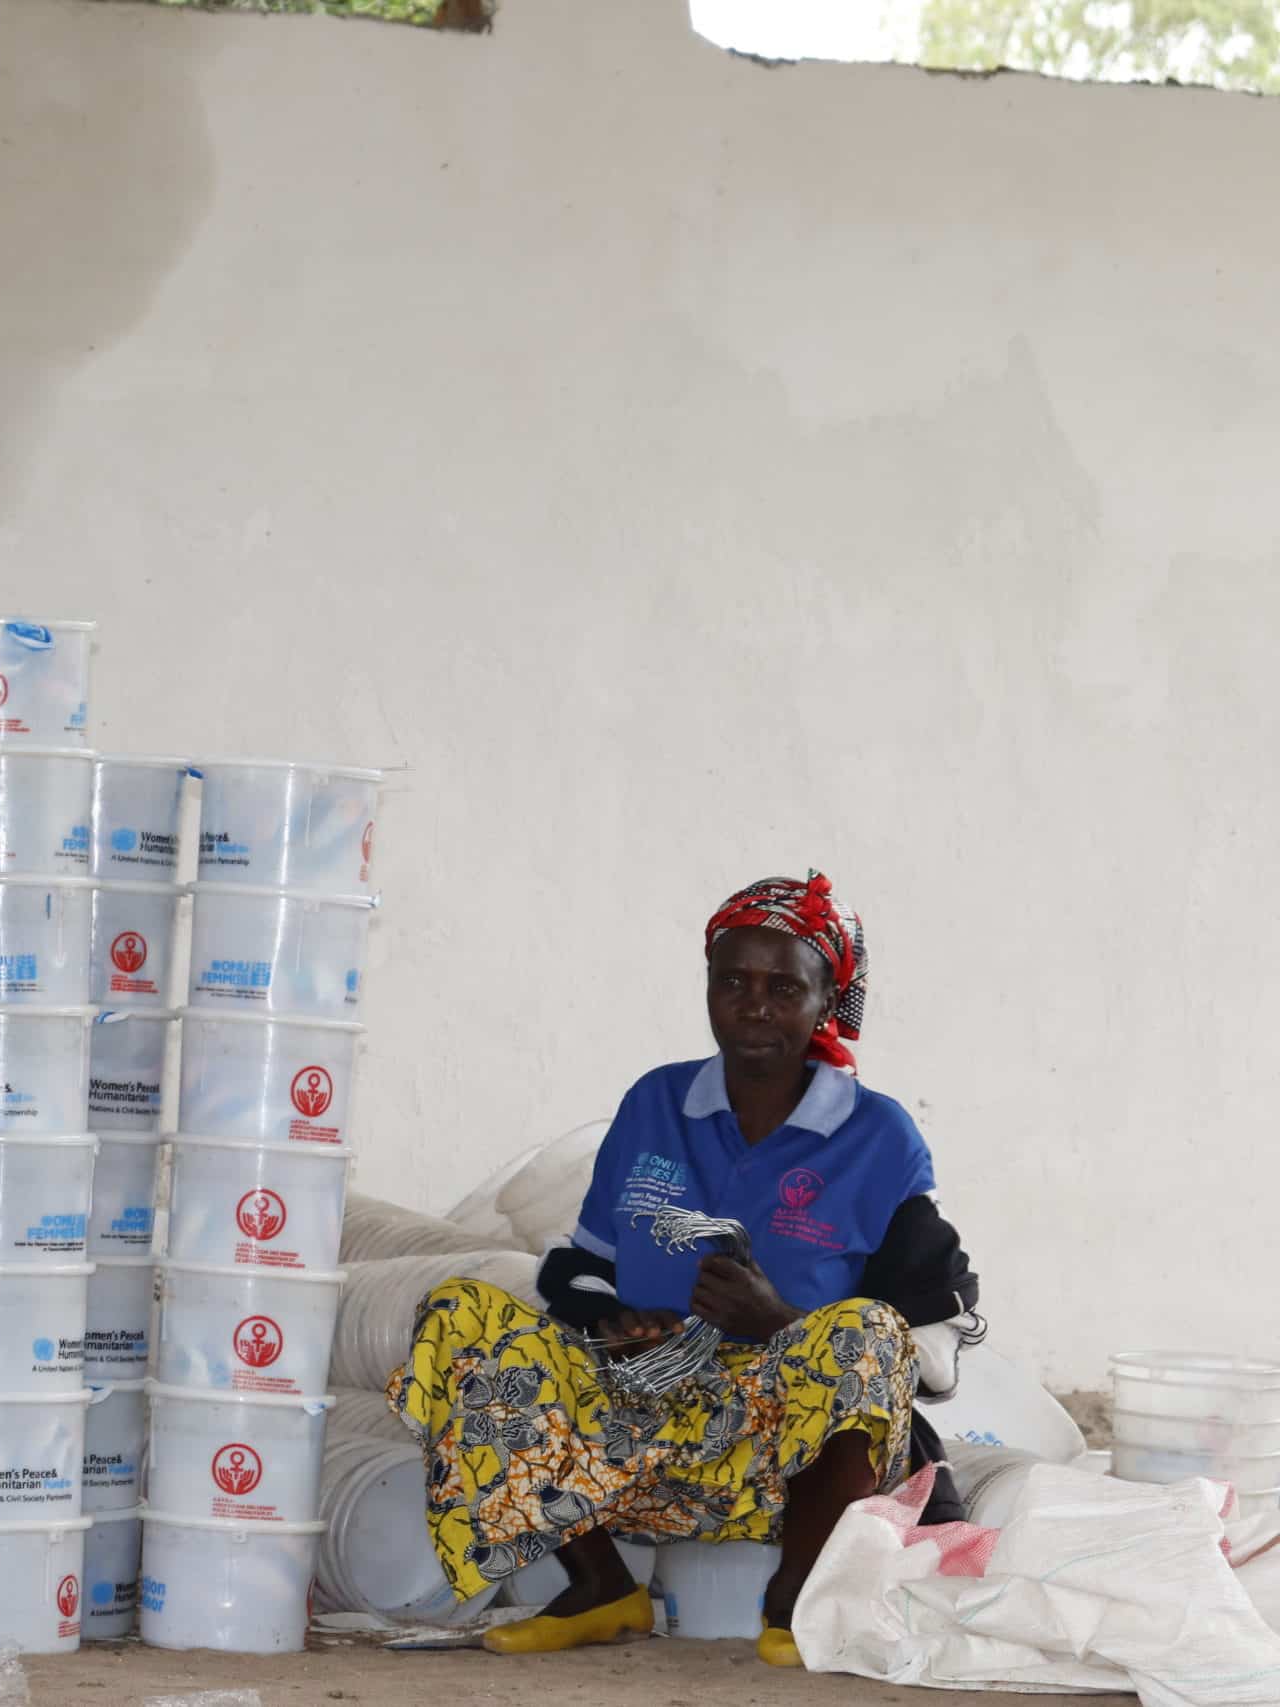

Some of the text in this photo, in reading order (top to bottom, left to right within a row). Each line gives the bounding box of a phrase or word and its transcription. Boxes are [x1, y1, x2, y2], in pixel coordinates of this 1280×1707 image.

[89, 1079, 136, 1092] Women's
[0, 1106, 39, 1117] Prtnership
[649, 1155, 677, 1171] ONU
[85, 1341, 133, 1352] manitarian
[89, 1454, 123, 1466] Peace&
[22, 1469, 57, 1480] Peace&
[6, 1494, 22, 1503] Civil
[22, 1495, 45, 1504] Society
